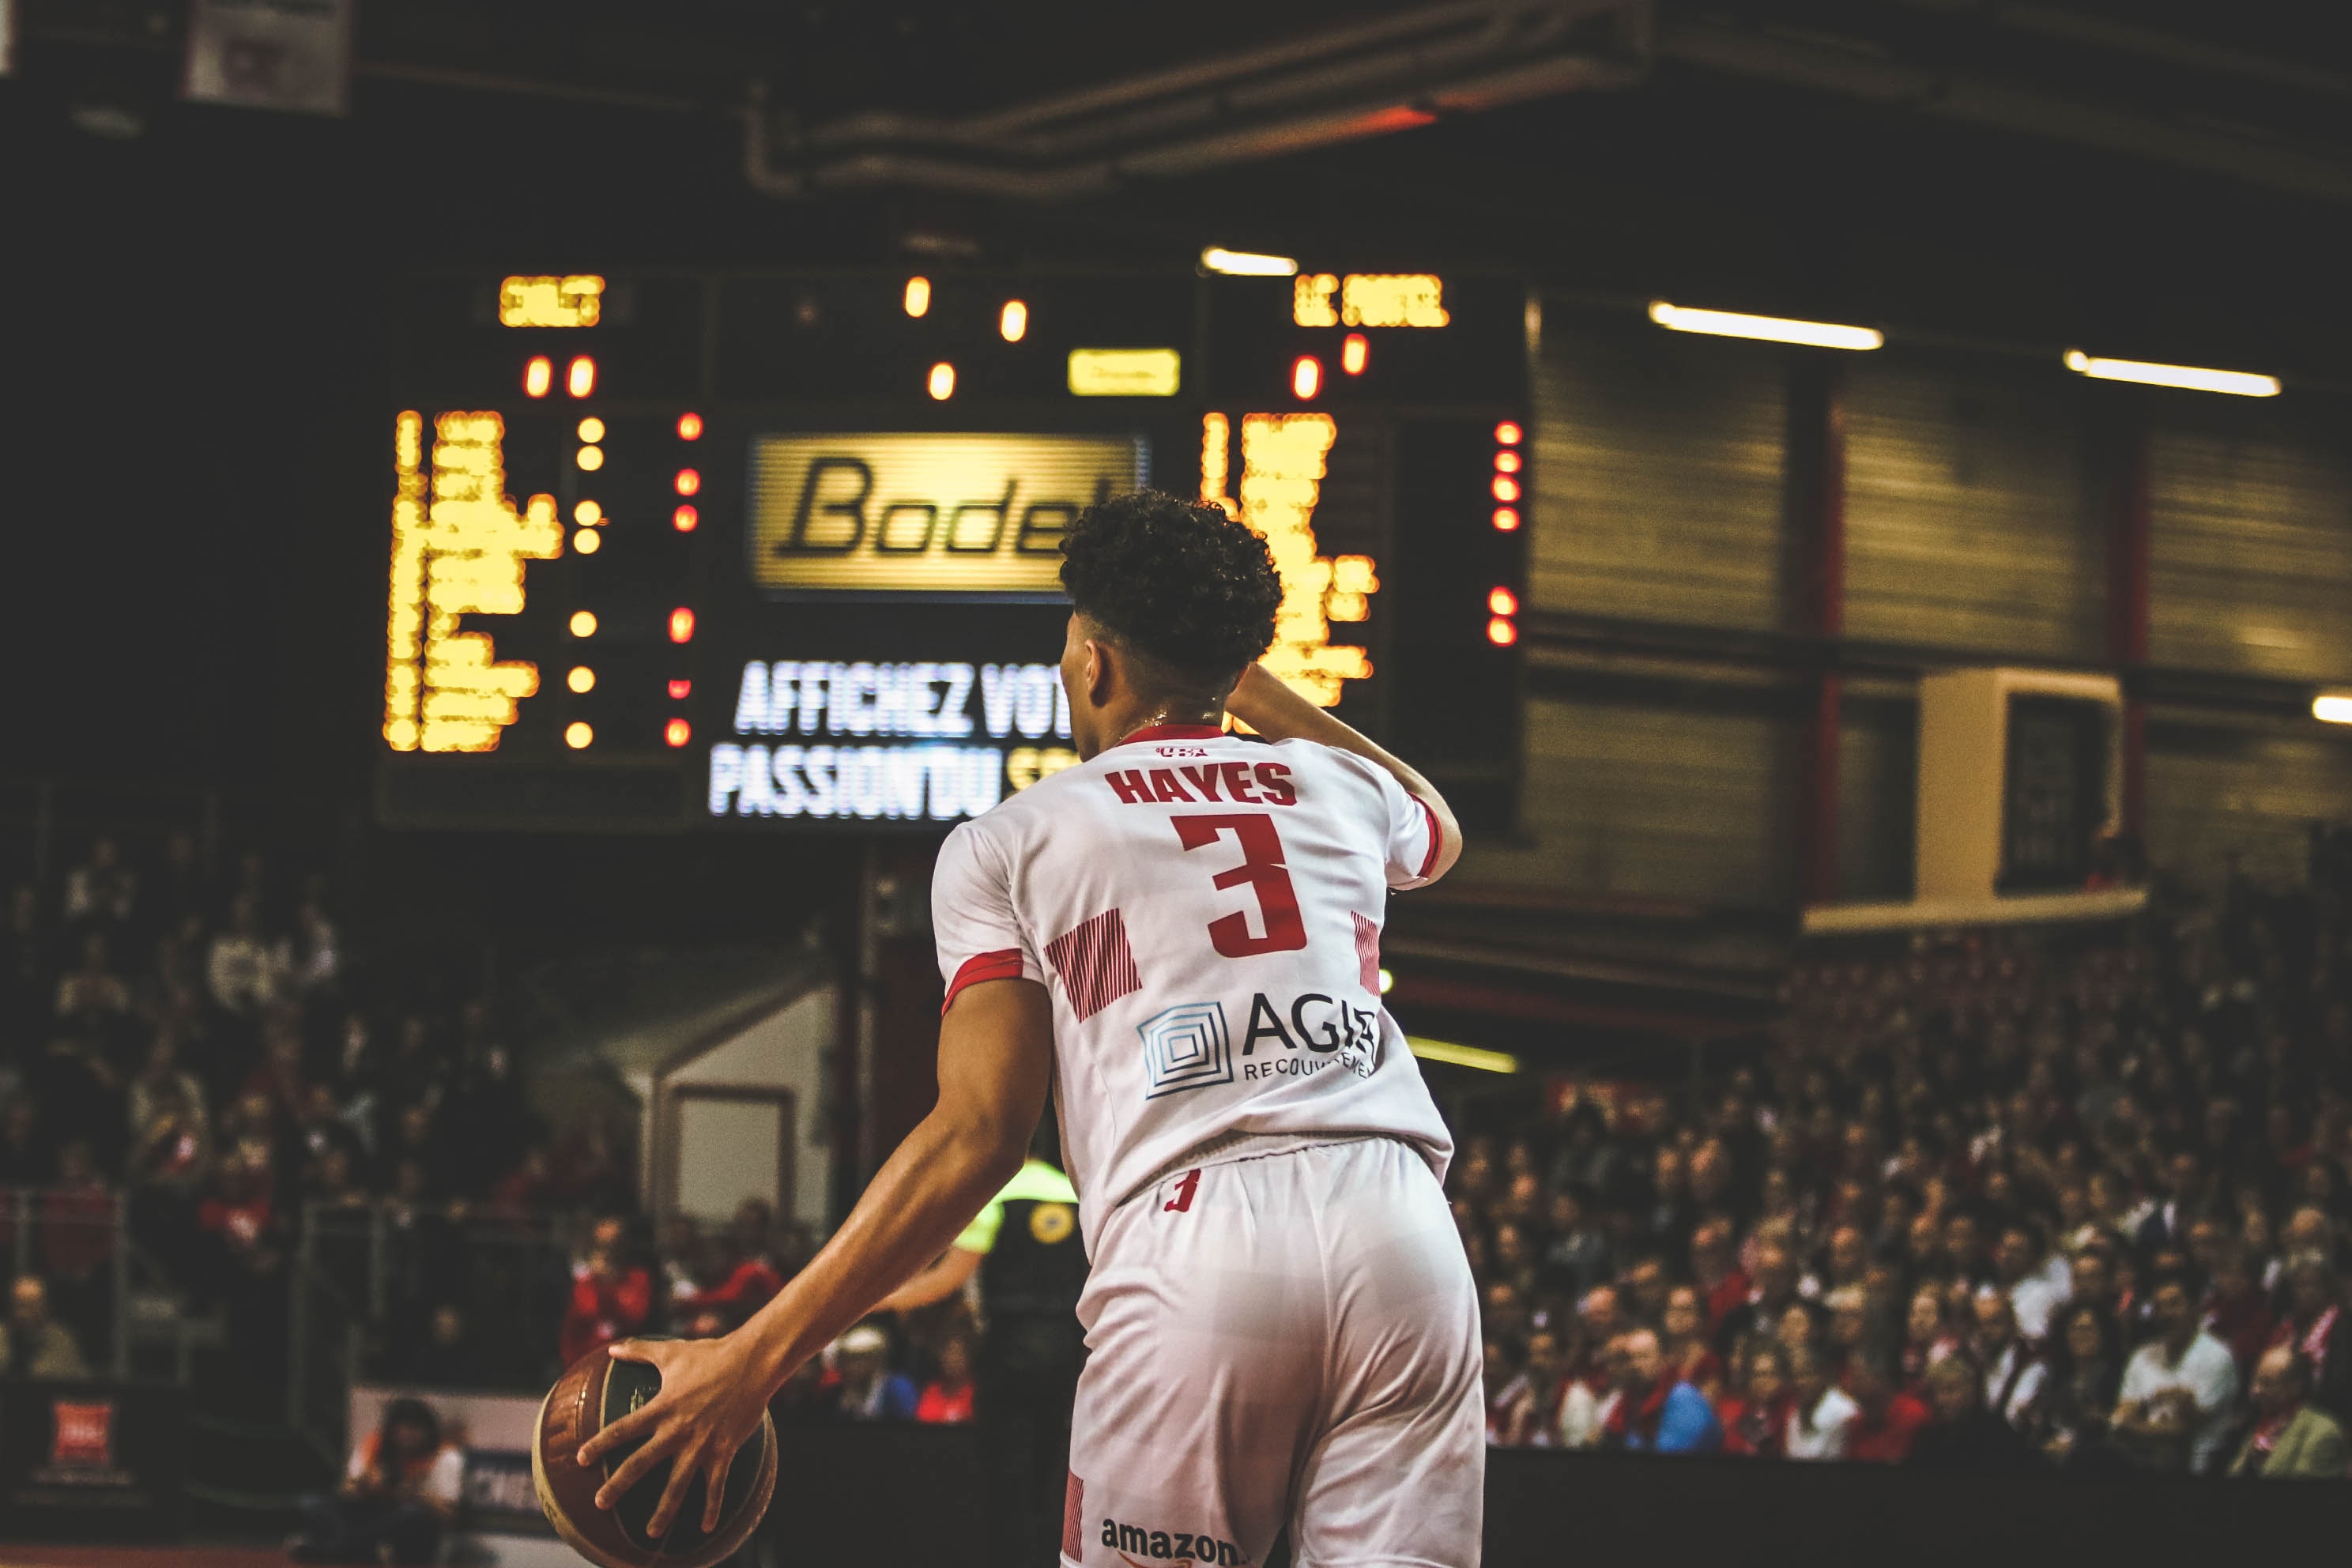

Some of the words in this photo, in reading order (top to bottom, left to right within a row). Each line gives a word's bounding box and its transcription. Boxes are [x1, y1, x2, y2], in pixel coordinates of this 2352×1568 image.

[776, 457, 1111, 559] Bode
[735, 662, 974, 736] AFFICHEZ
[1105, 762, 1297, 806] HAYES
[1170, 813, 1307, 958] 3
